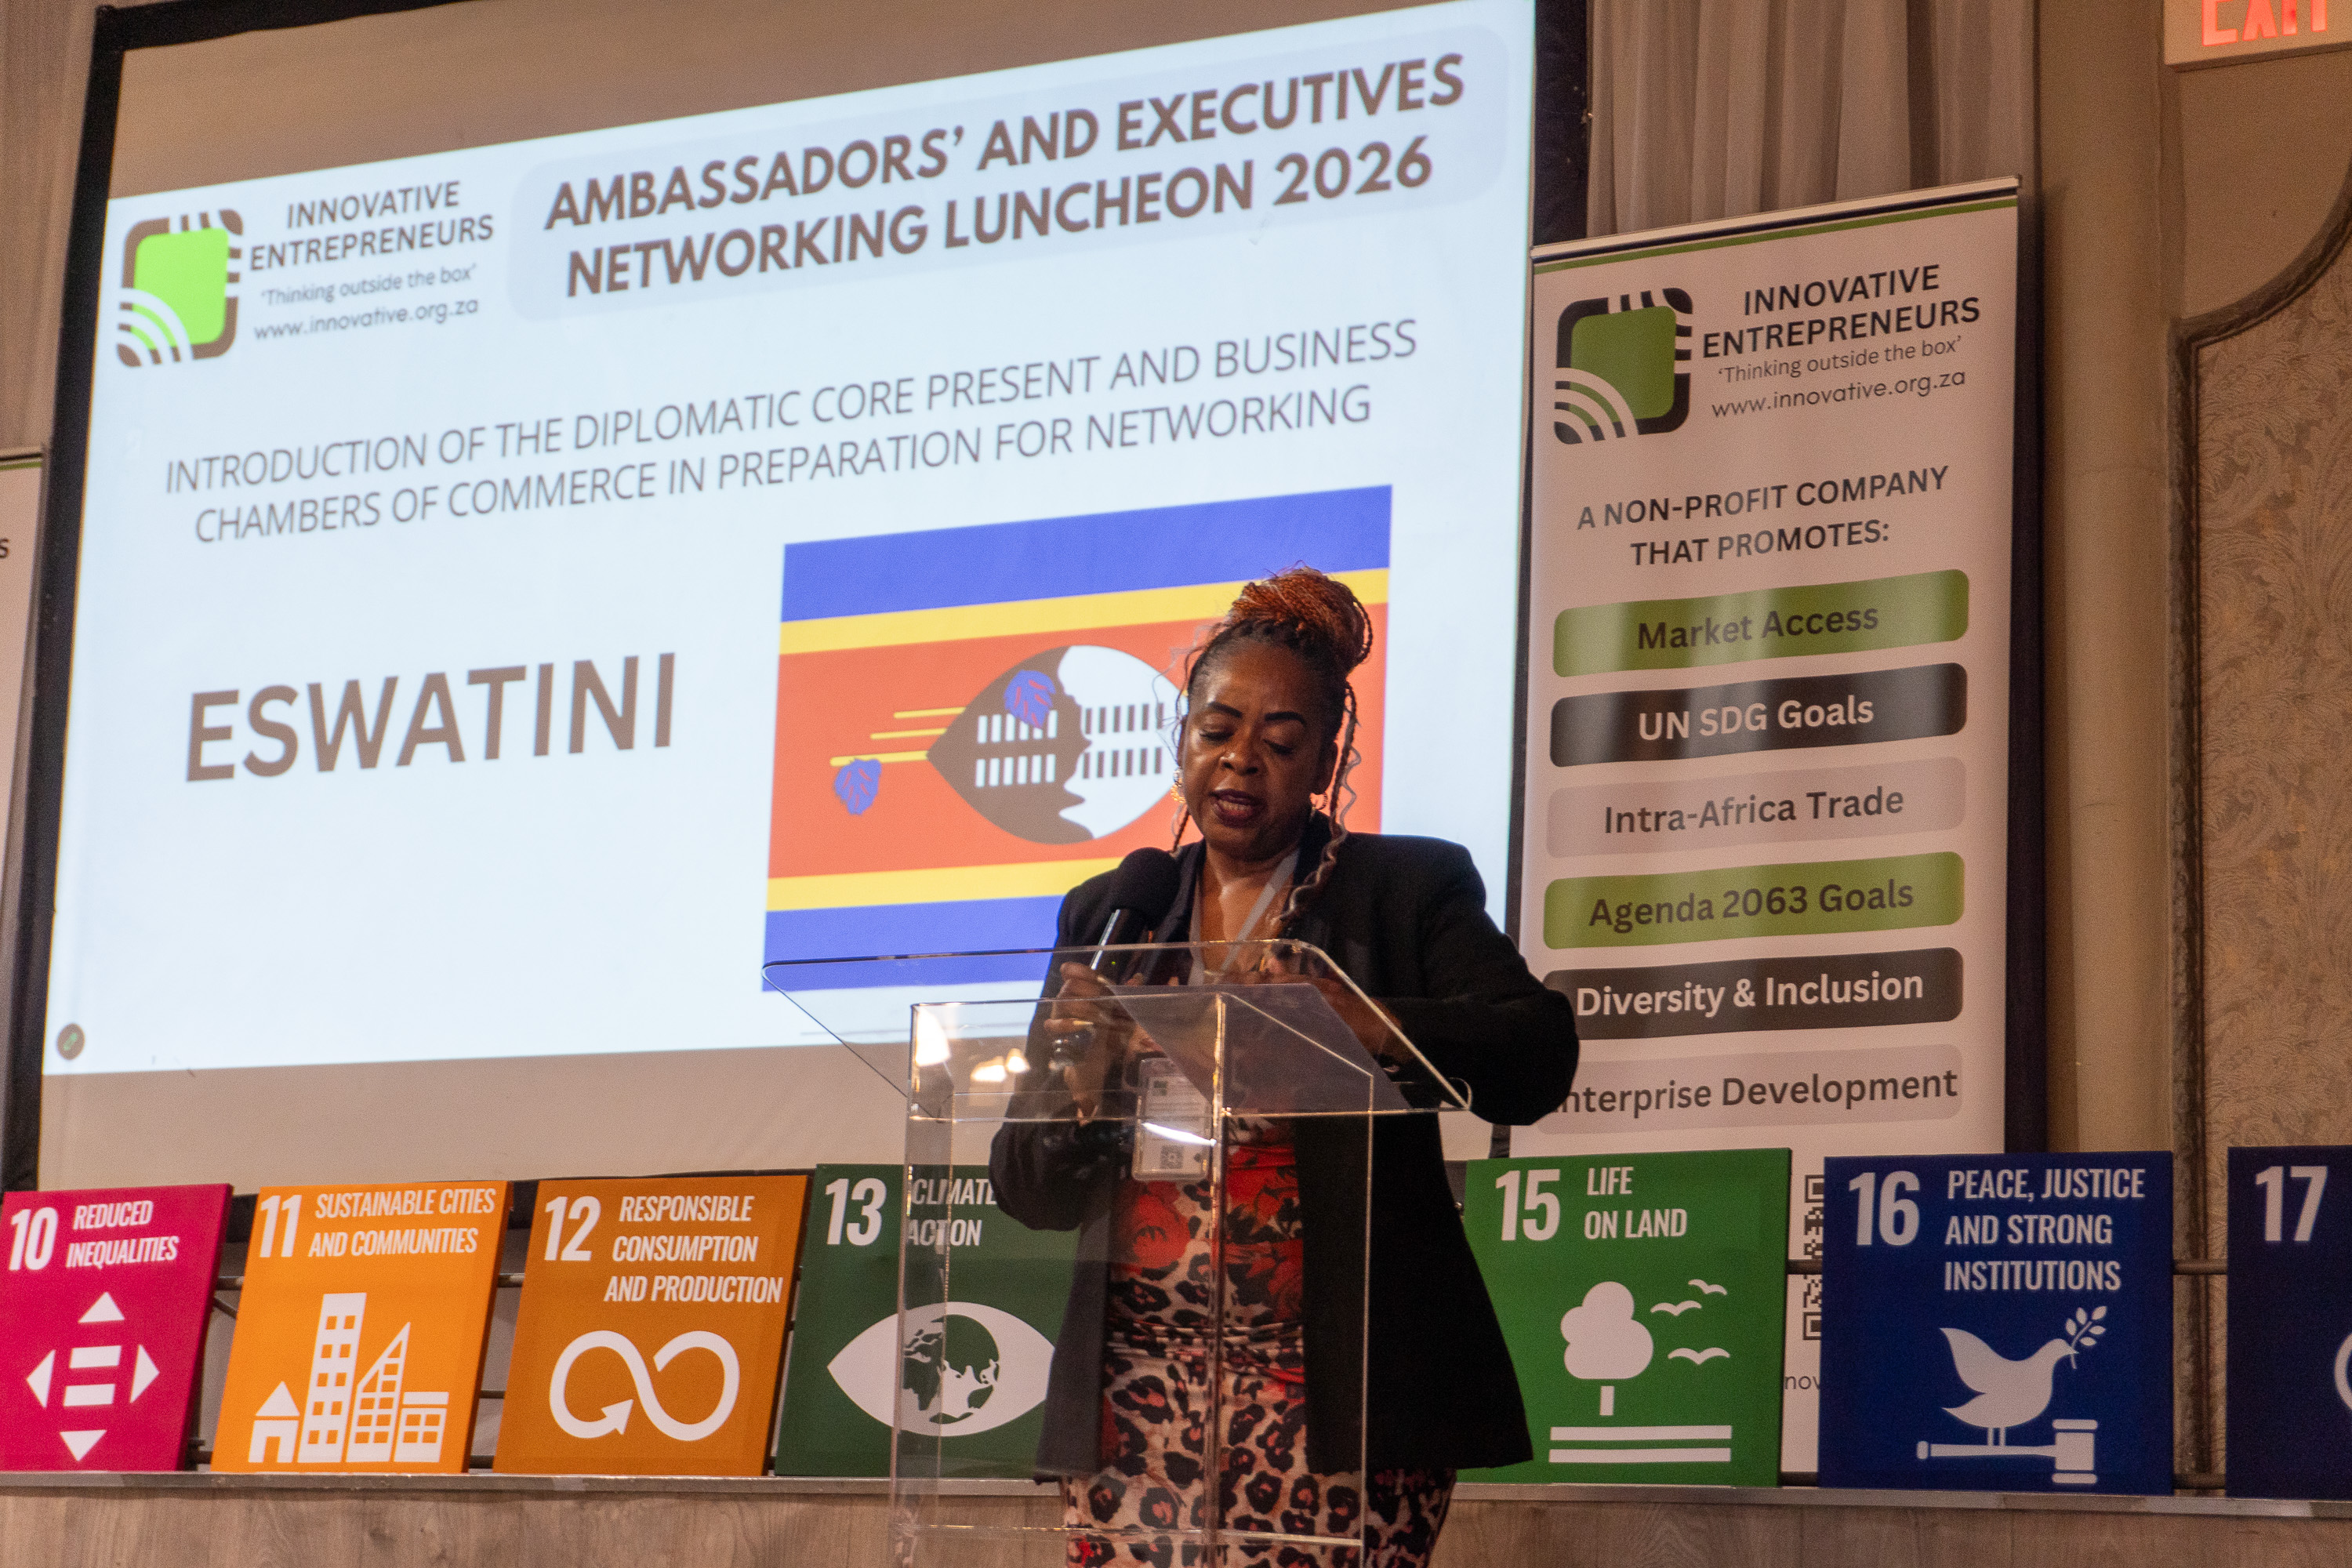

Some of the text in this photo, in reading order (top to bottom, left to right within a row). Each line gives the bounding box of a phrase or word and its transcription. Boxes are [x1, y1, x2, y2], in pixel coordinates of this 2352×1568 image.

[977, 109, 1099, 172] AND
[1116, 53, 1465, 151] EXECUTIVES
[287, 180, 461, 229] INNOVATIVE
[567, 136, 1433, 297] NETWORKING LUNCHEON 2026
[250, 215, 493, 270] ENTREPRENEURS
[340, 275, 403, 299] outside
[408, 270, 435, 292] the
[1744, 263, 1940, 316] INNOVATIVE
[254, 297, 478, 340] www.innovative.org.za
[1703, 296, 1980, 358] ENTREPRENEURS
[1806, 347, 1879, 372] outside
[1884, 343, 1915, 362] the
[166, 320, 1417, 494] INTRODUCTION OF THE DIPLOMATIC CORE PRESENT AND BUSINESS
[1711, 368, 1965, 418] www.innovative.org.za
[195, 385, 1371, 543] CHAMBERS OF COMMERCE IN PREPARATION FOR NETWORKING
[1577, 466, 1950, 530] A NON-PROFIT COMPANY
[1631, 520, 1889, 565] THAT PROMOTES:
[1638, 604, 1879, 650] Market Access
[187, 651, 676, 782] ESWATINI
[1639, 695, 1874, 740] UN SDG Goals
[1604, 785, 1904, 833] Intra-Africa Trade
[1589, 879, 1913, 933] Agenda 2063 Goals
[1576, 971, 1924, 1018] Diversity & Inclusion
[1552, 1069, 1958, 1119] nterprise Development
[315, 1189, 496, 1218] SUSTAINABLE CITIES
[1495, 1169, 1560, 1241] 15
[1587, 1167, 1634, 1196] LIFE
[1947, 1168, 2145, 1202] PEACE, JUSTICE
[2256, 1165, 2328, 1241] 17
[72, 1200, 153, 1229] REDUCED
[259, 1195, 302, 1257] 11
[543, 1196, 601, 1261] 12
[619, 1195, 754, 1221] RESPONSIBLE
[825, 1178, 887, 1245] 13
[1584, 1208, 1688, 1240] ON LAND
[1848, 1171, 1920, 1246] 16
[1944, 1214, 2113, 1244] AND STRONG
[9, 1207, 58, 1271] 10
[66, 1236, 180, 1269] INEQUALITIES
[309, 1228, 477, 1257] AND COMMUNITIES
[612, 1236, 758, 1262] CONSUMPTION
[604, 1276, 783, 1303] AND PRODUCTION
[1944, 1261, 2122, 1291] INSTITUTIONS
